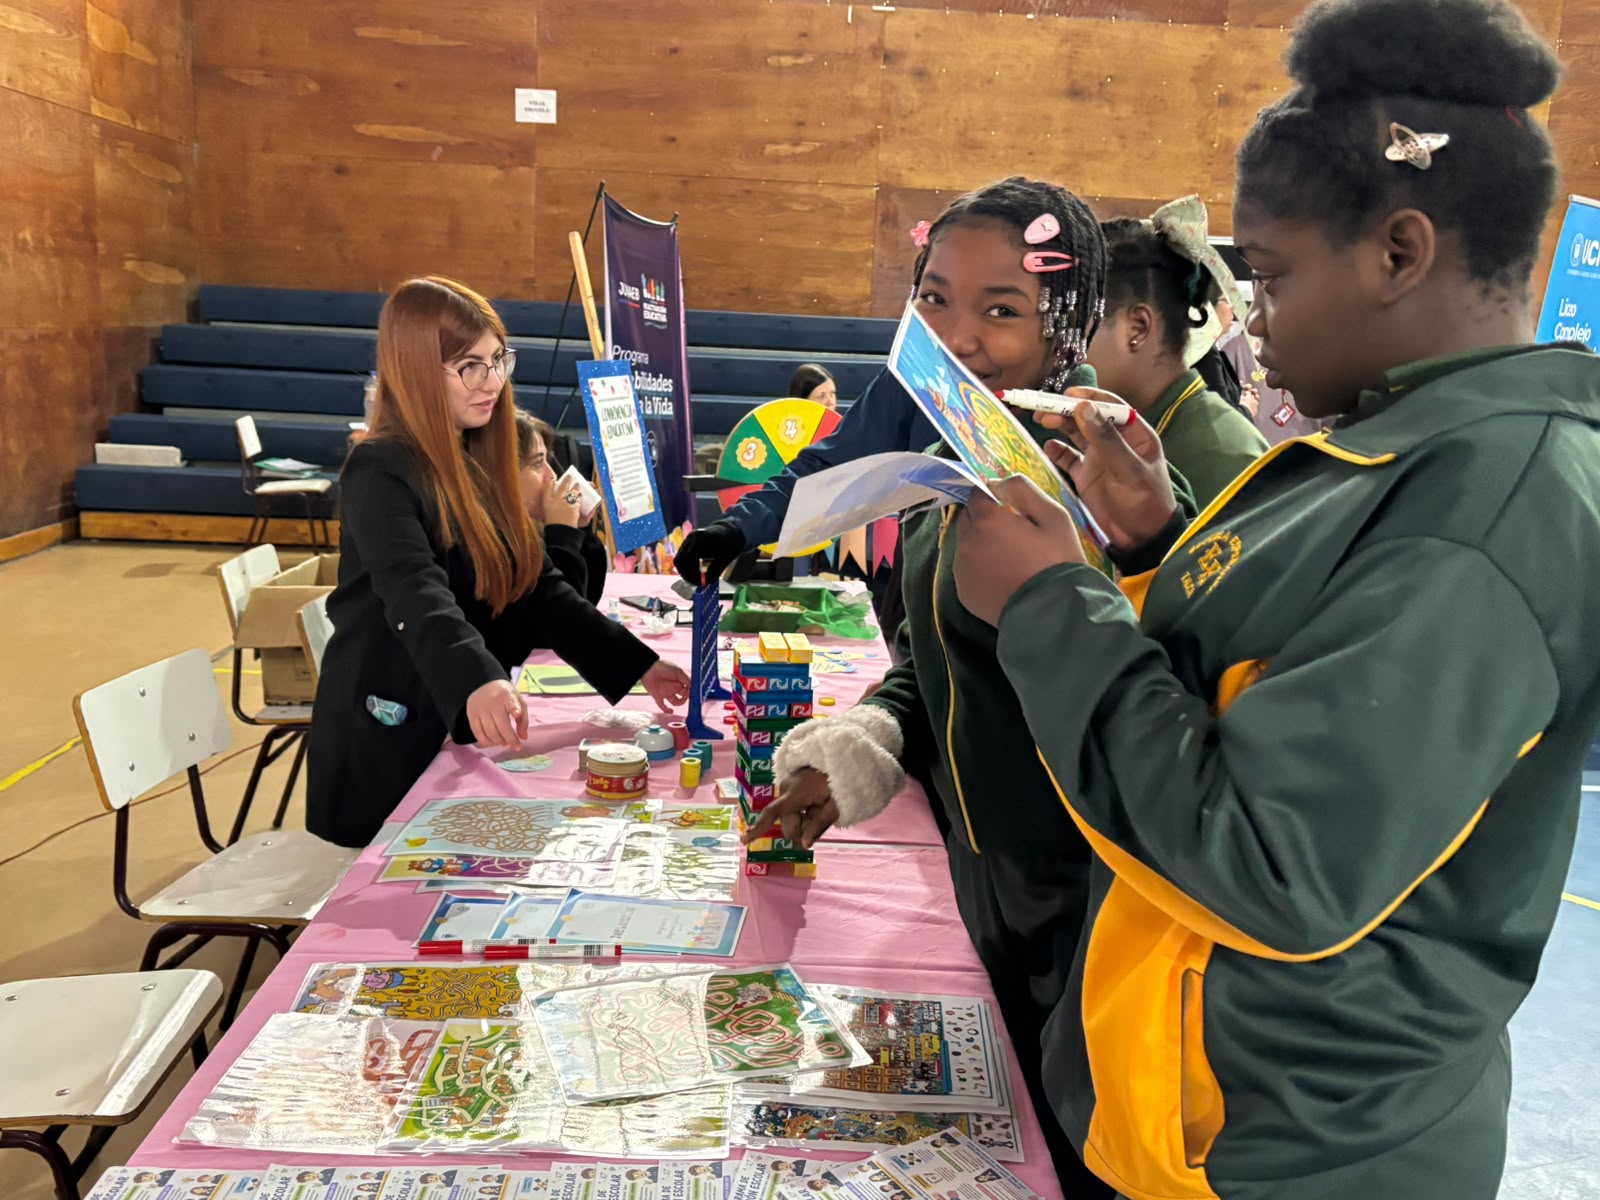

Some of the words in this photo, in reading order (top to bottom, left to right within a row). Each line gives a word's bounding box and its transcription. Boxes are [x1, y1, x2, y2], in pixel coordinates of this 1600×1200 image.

[633, 371, 673, 392] bilidades
[652, 397, 674, 416] Vida
[784, 419, 798, 439] 4
[742, 441, 759, 462] 3
[673, 1169, 685, 1197] ESCOLAR
[750, 1163, 767, 1189] ESCOLAR
[102, 1176, 129, 1200] SCOLAR
[271, 1176, 292, 1200] SCOLAR
